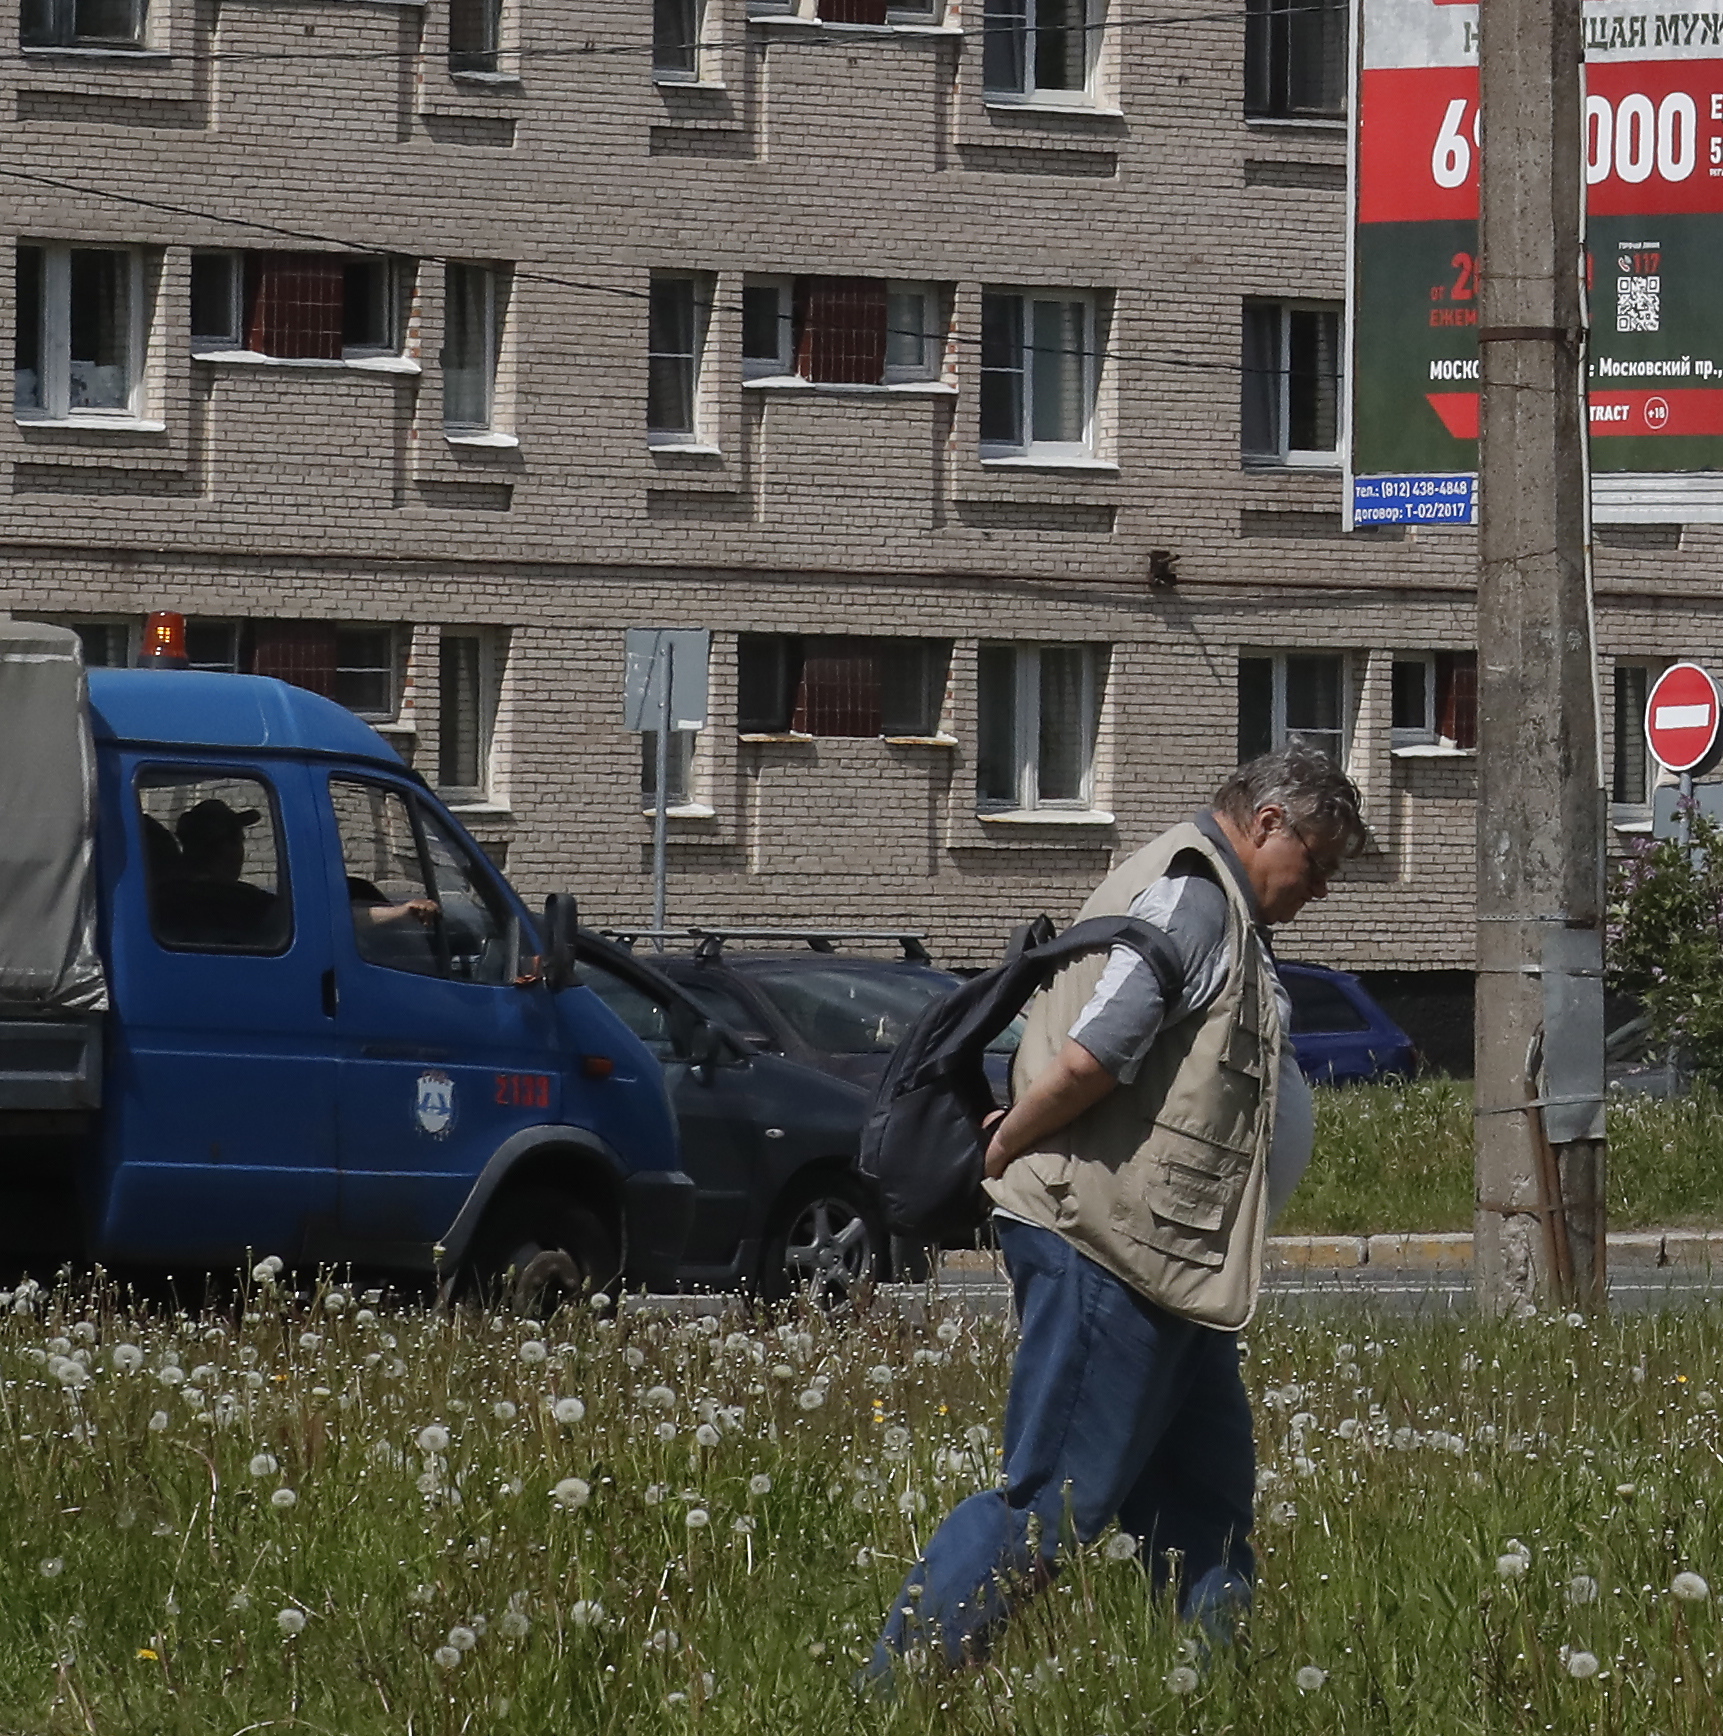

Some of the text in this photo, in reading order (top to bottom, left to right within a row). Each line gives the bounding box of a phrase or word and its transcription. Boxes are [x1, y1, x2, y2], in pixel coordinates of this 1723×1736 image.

[1599, 356, 1690, 377] Московский
[1695, 360, 1723, 380] пр.,
[1381, 481, 1410, 498] (812)
[1412, 481, 1468, 495] 438-4848
